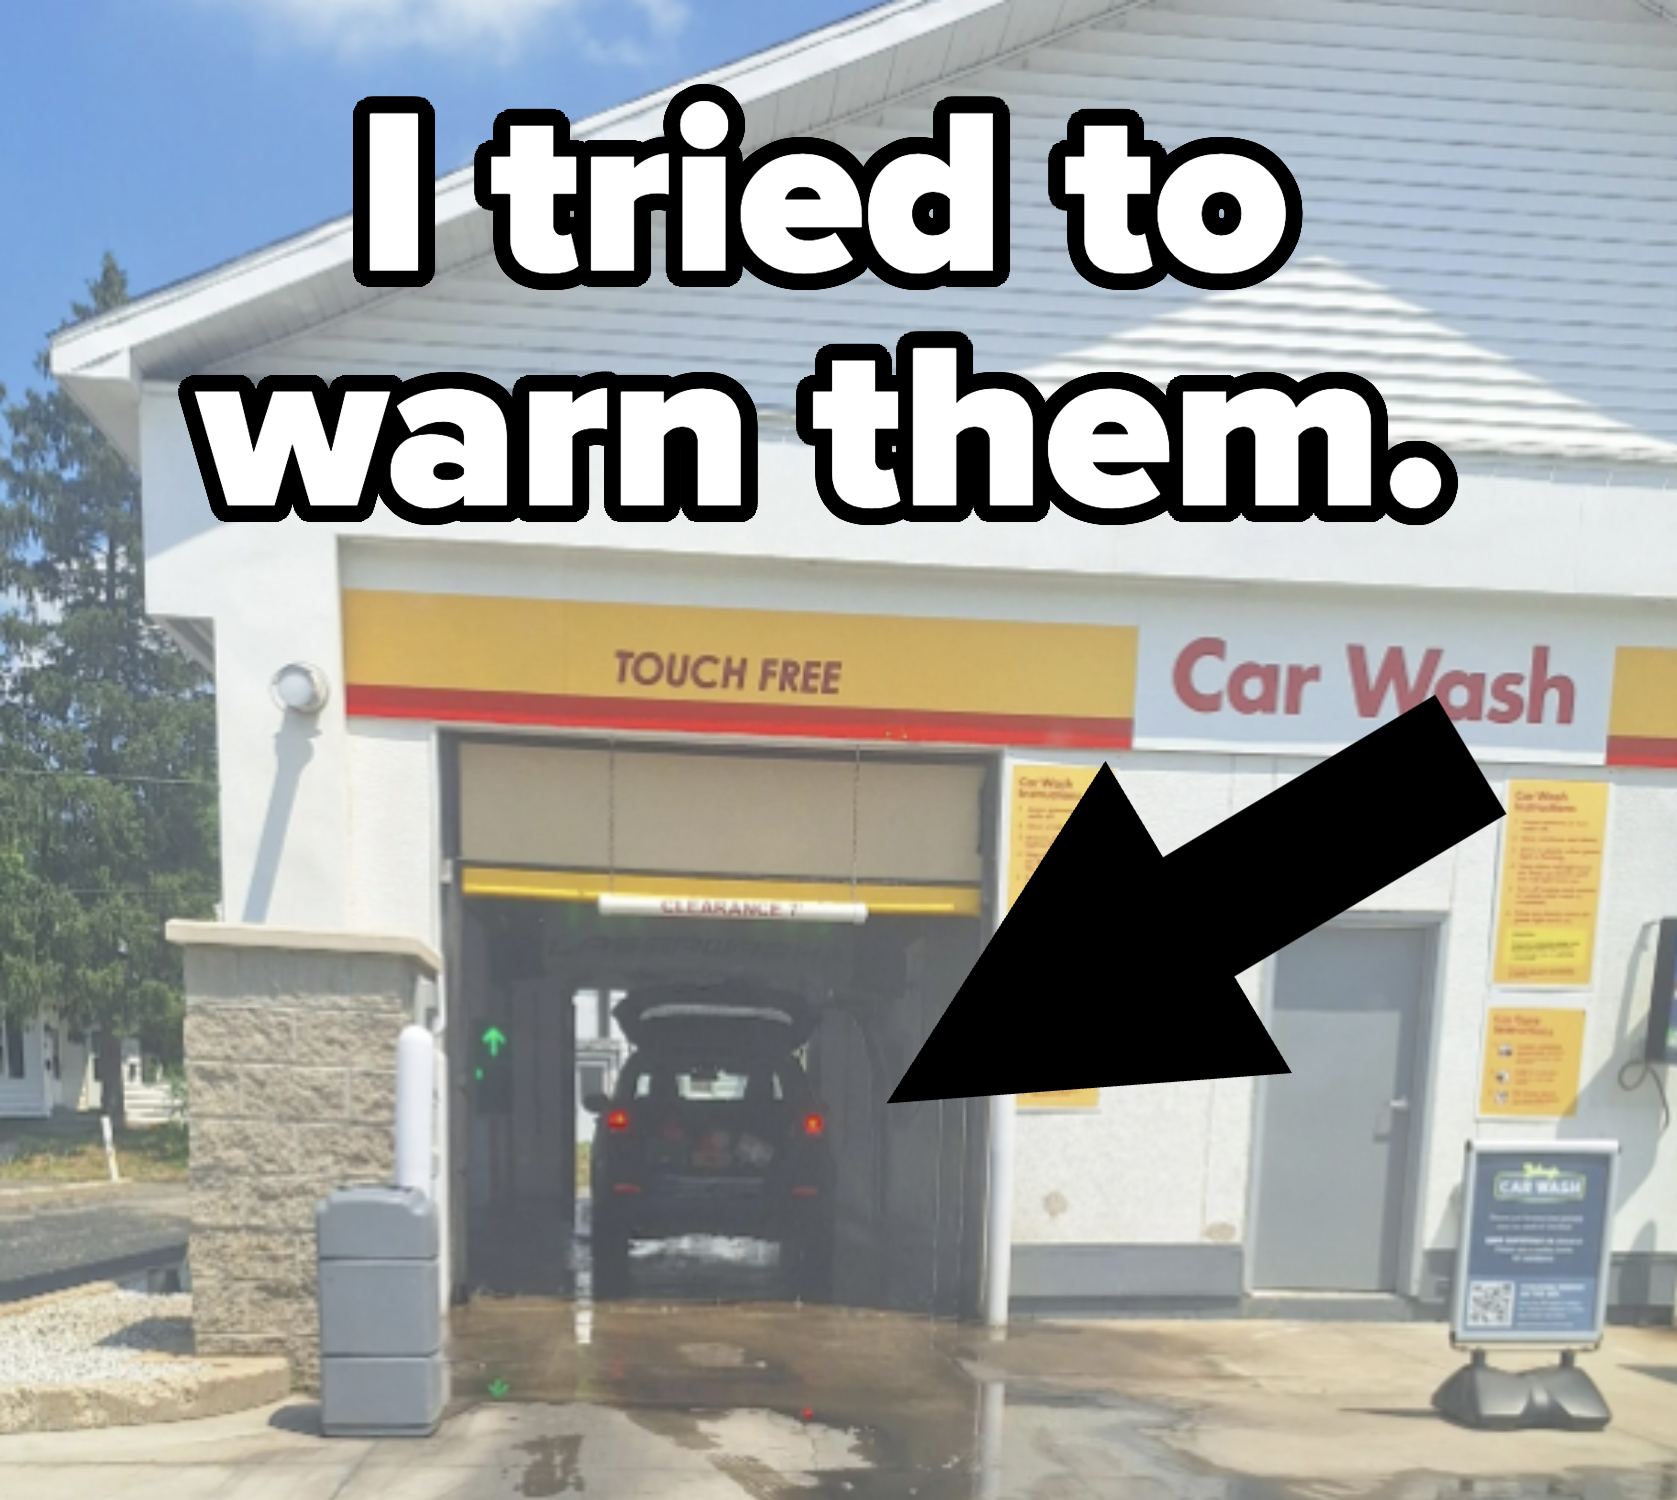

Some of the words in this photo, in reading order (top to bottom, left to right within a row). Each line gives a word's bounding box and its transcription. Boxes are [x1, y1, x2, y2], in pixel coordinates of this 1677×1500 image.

[615, 650, 748, 690] TOUCH
[758, 658, 843, 694] FREE
[1172, 636, 1321, 716] Car
[1346, 643, 1576, 724] Wash
[660, 899, 783, 918] CLEARANCE
[1498, 1179, 1532, 1195] CAR
[1535, 1179, 1581, 1195] WASH
